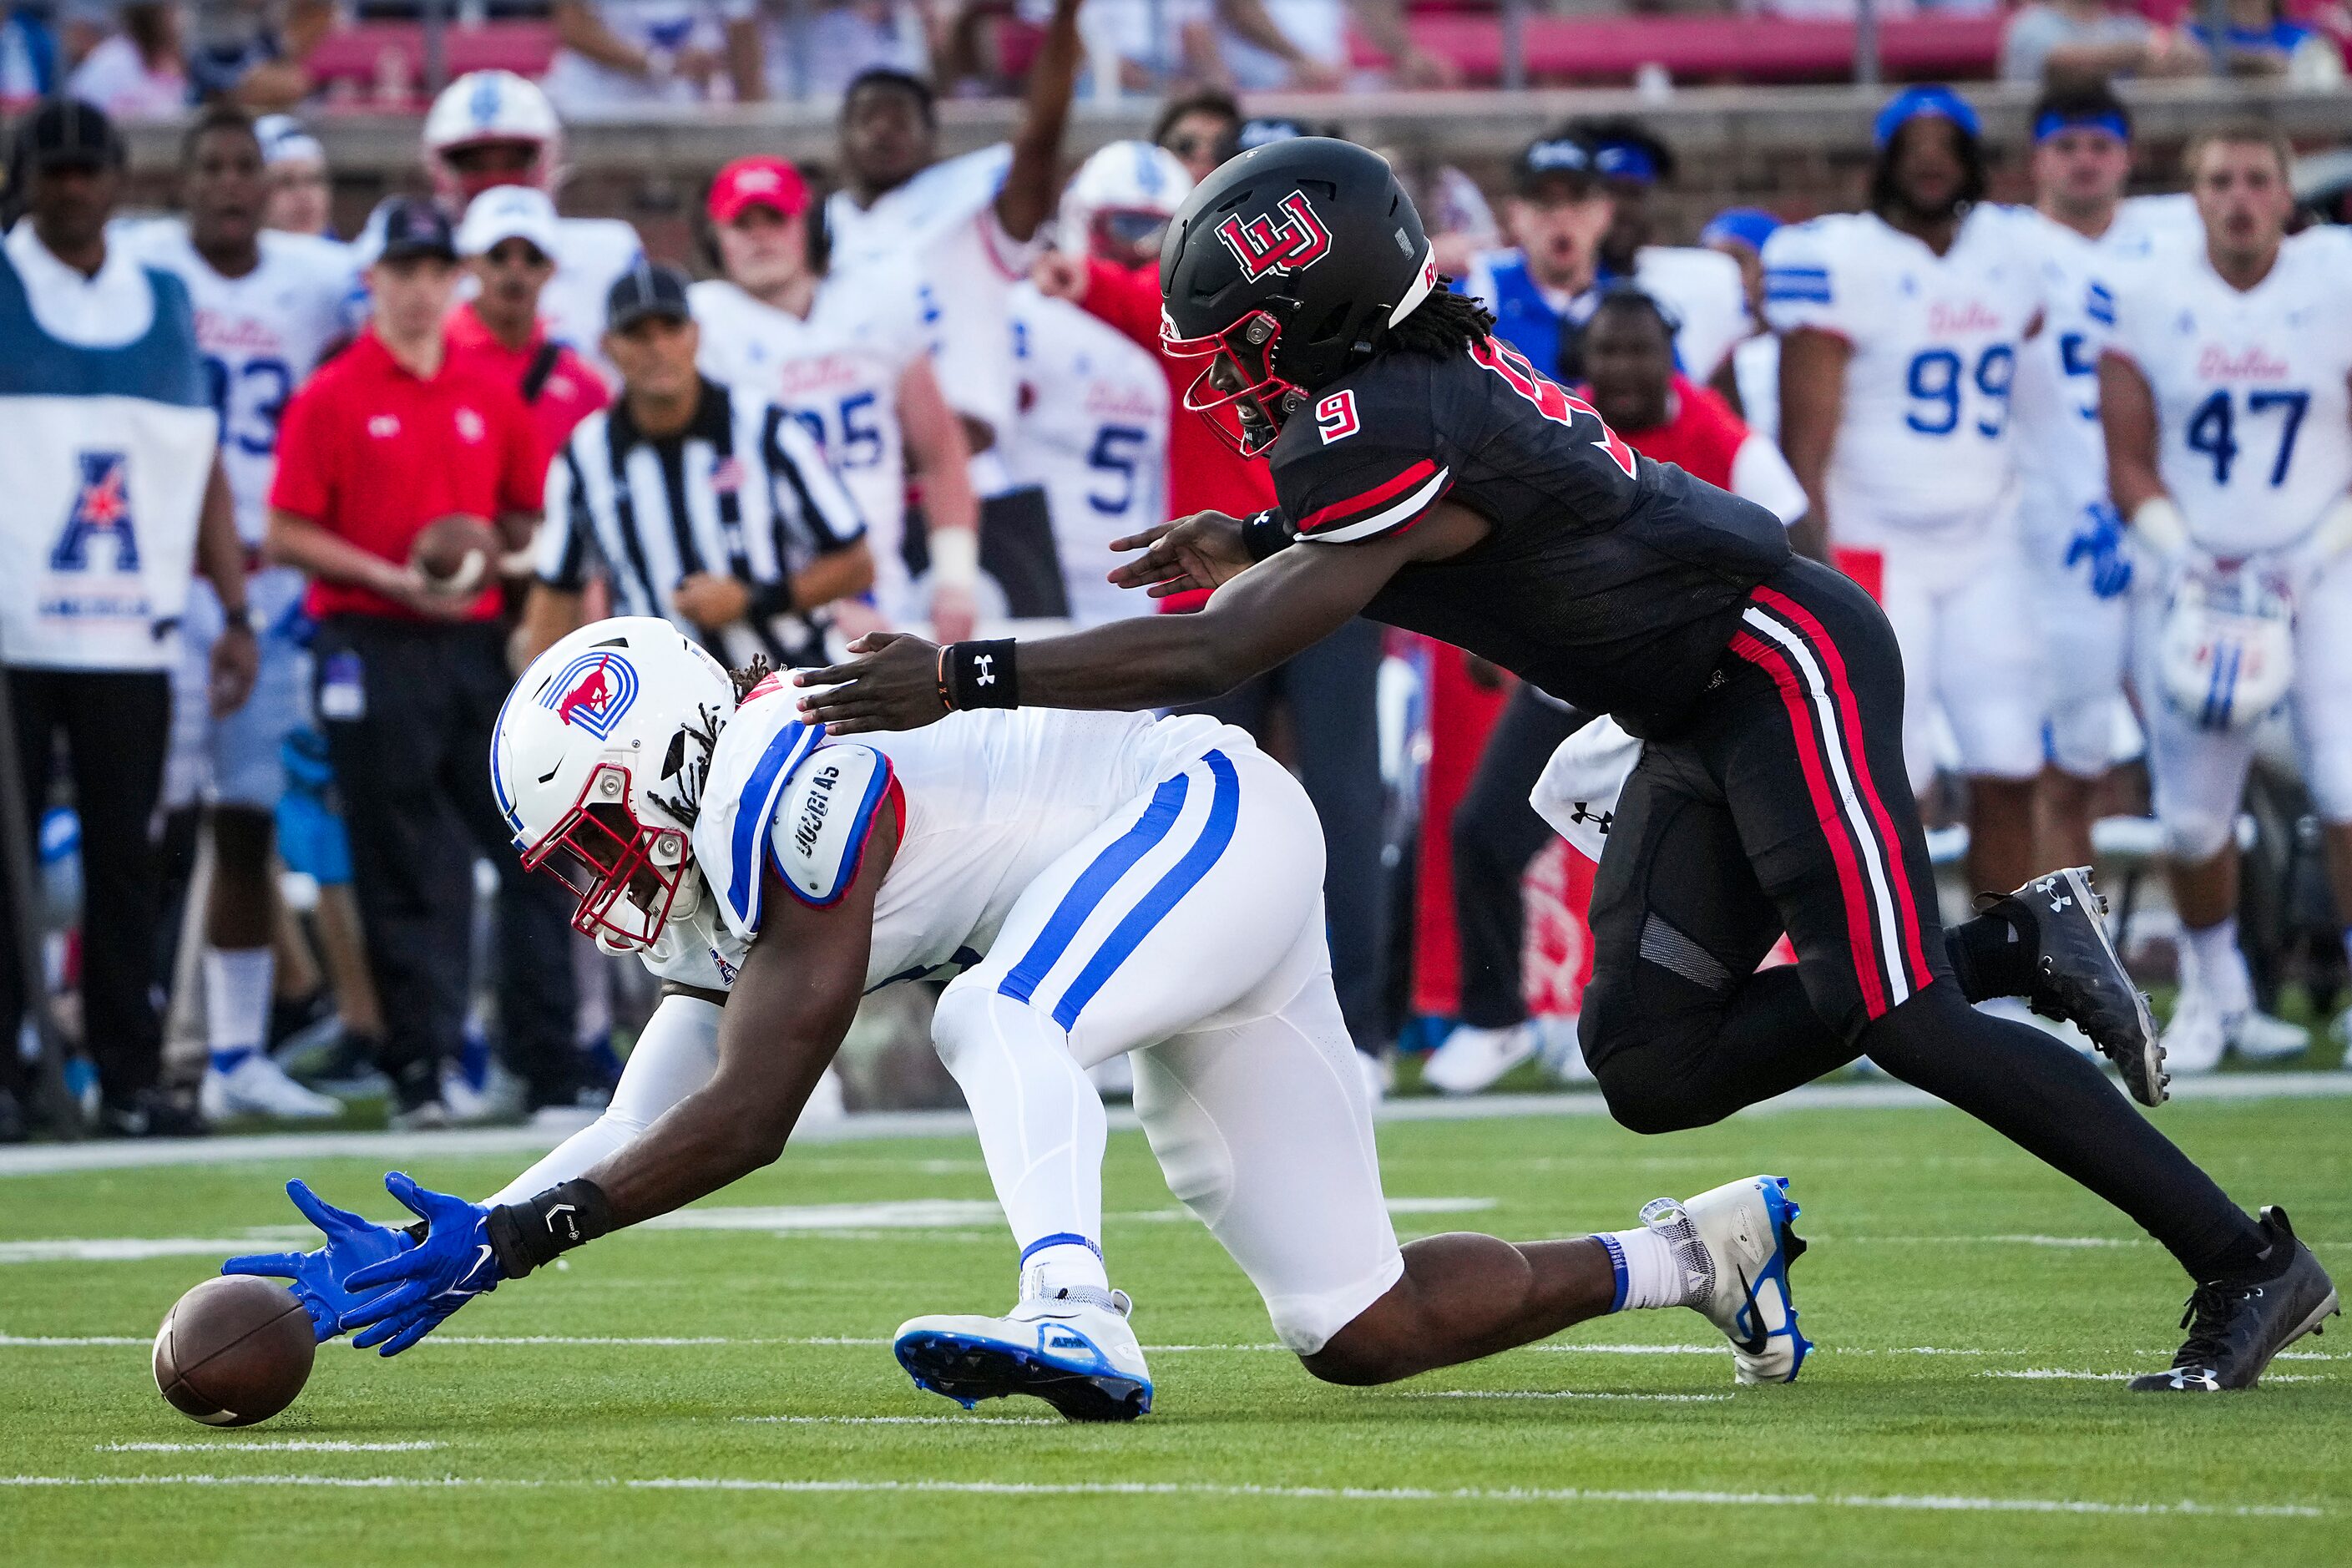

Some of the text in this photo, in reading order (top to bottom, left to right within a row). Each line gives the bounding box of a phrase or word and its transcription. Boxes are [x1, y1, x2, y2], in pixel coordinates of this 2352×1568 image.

[1214, 190, 1333, 284] LU
[1315, 388, 1361, 445] 9
[1906, 346, 2016, 436] 99
[1088, 425, 1148, 517] 5
[2187, 389, 2310, 486] 47
[795, 766, 840, 859] DOUGLAS
[1050, 1336, 1087, 1348] ALPHA
